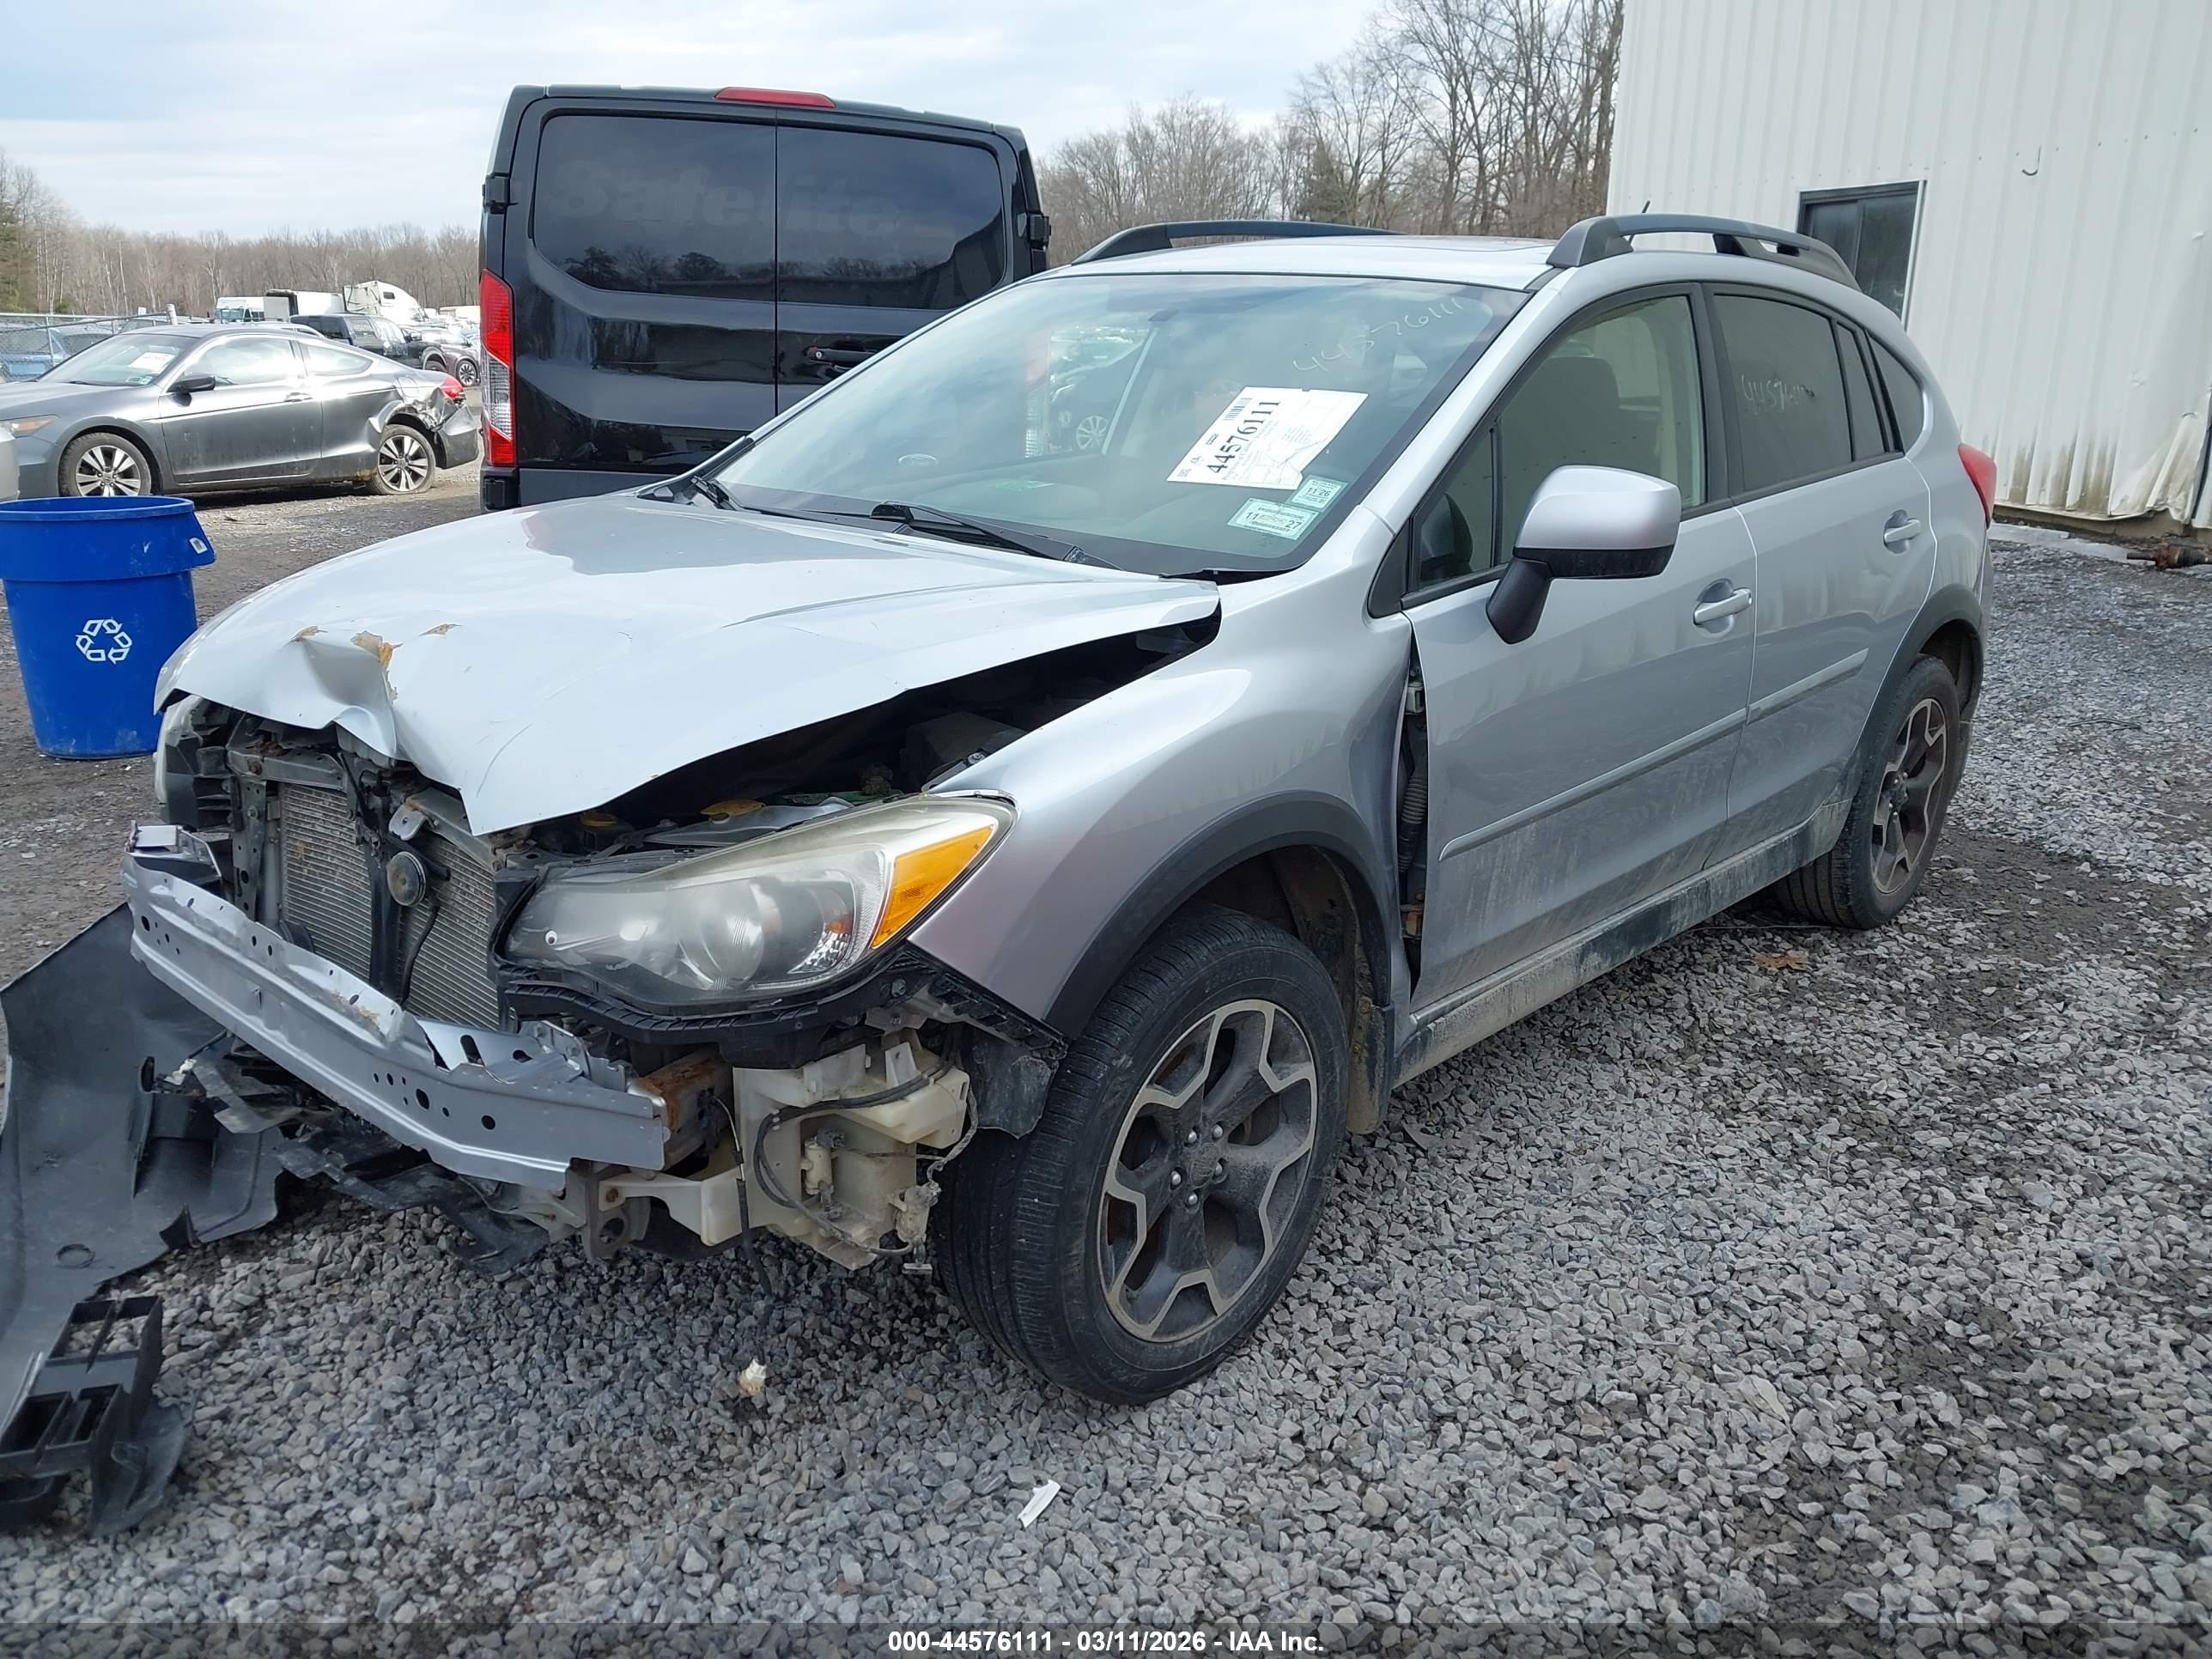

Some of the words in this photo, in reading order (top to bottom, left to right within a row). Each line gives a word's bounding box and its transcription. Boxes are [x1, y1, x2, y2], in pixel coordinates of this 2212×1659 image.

[1292, 297, 1463, 373] 44576111
[1206, 400, 1280, 475] 44576111
[1244, 511, 1260, 521] 11
[1285, 520, 1303, 530] 27
